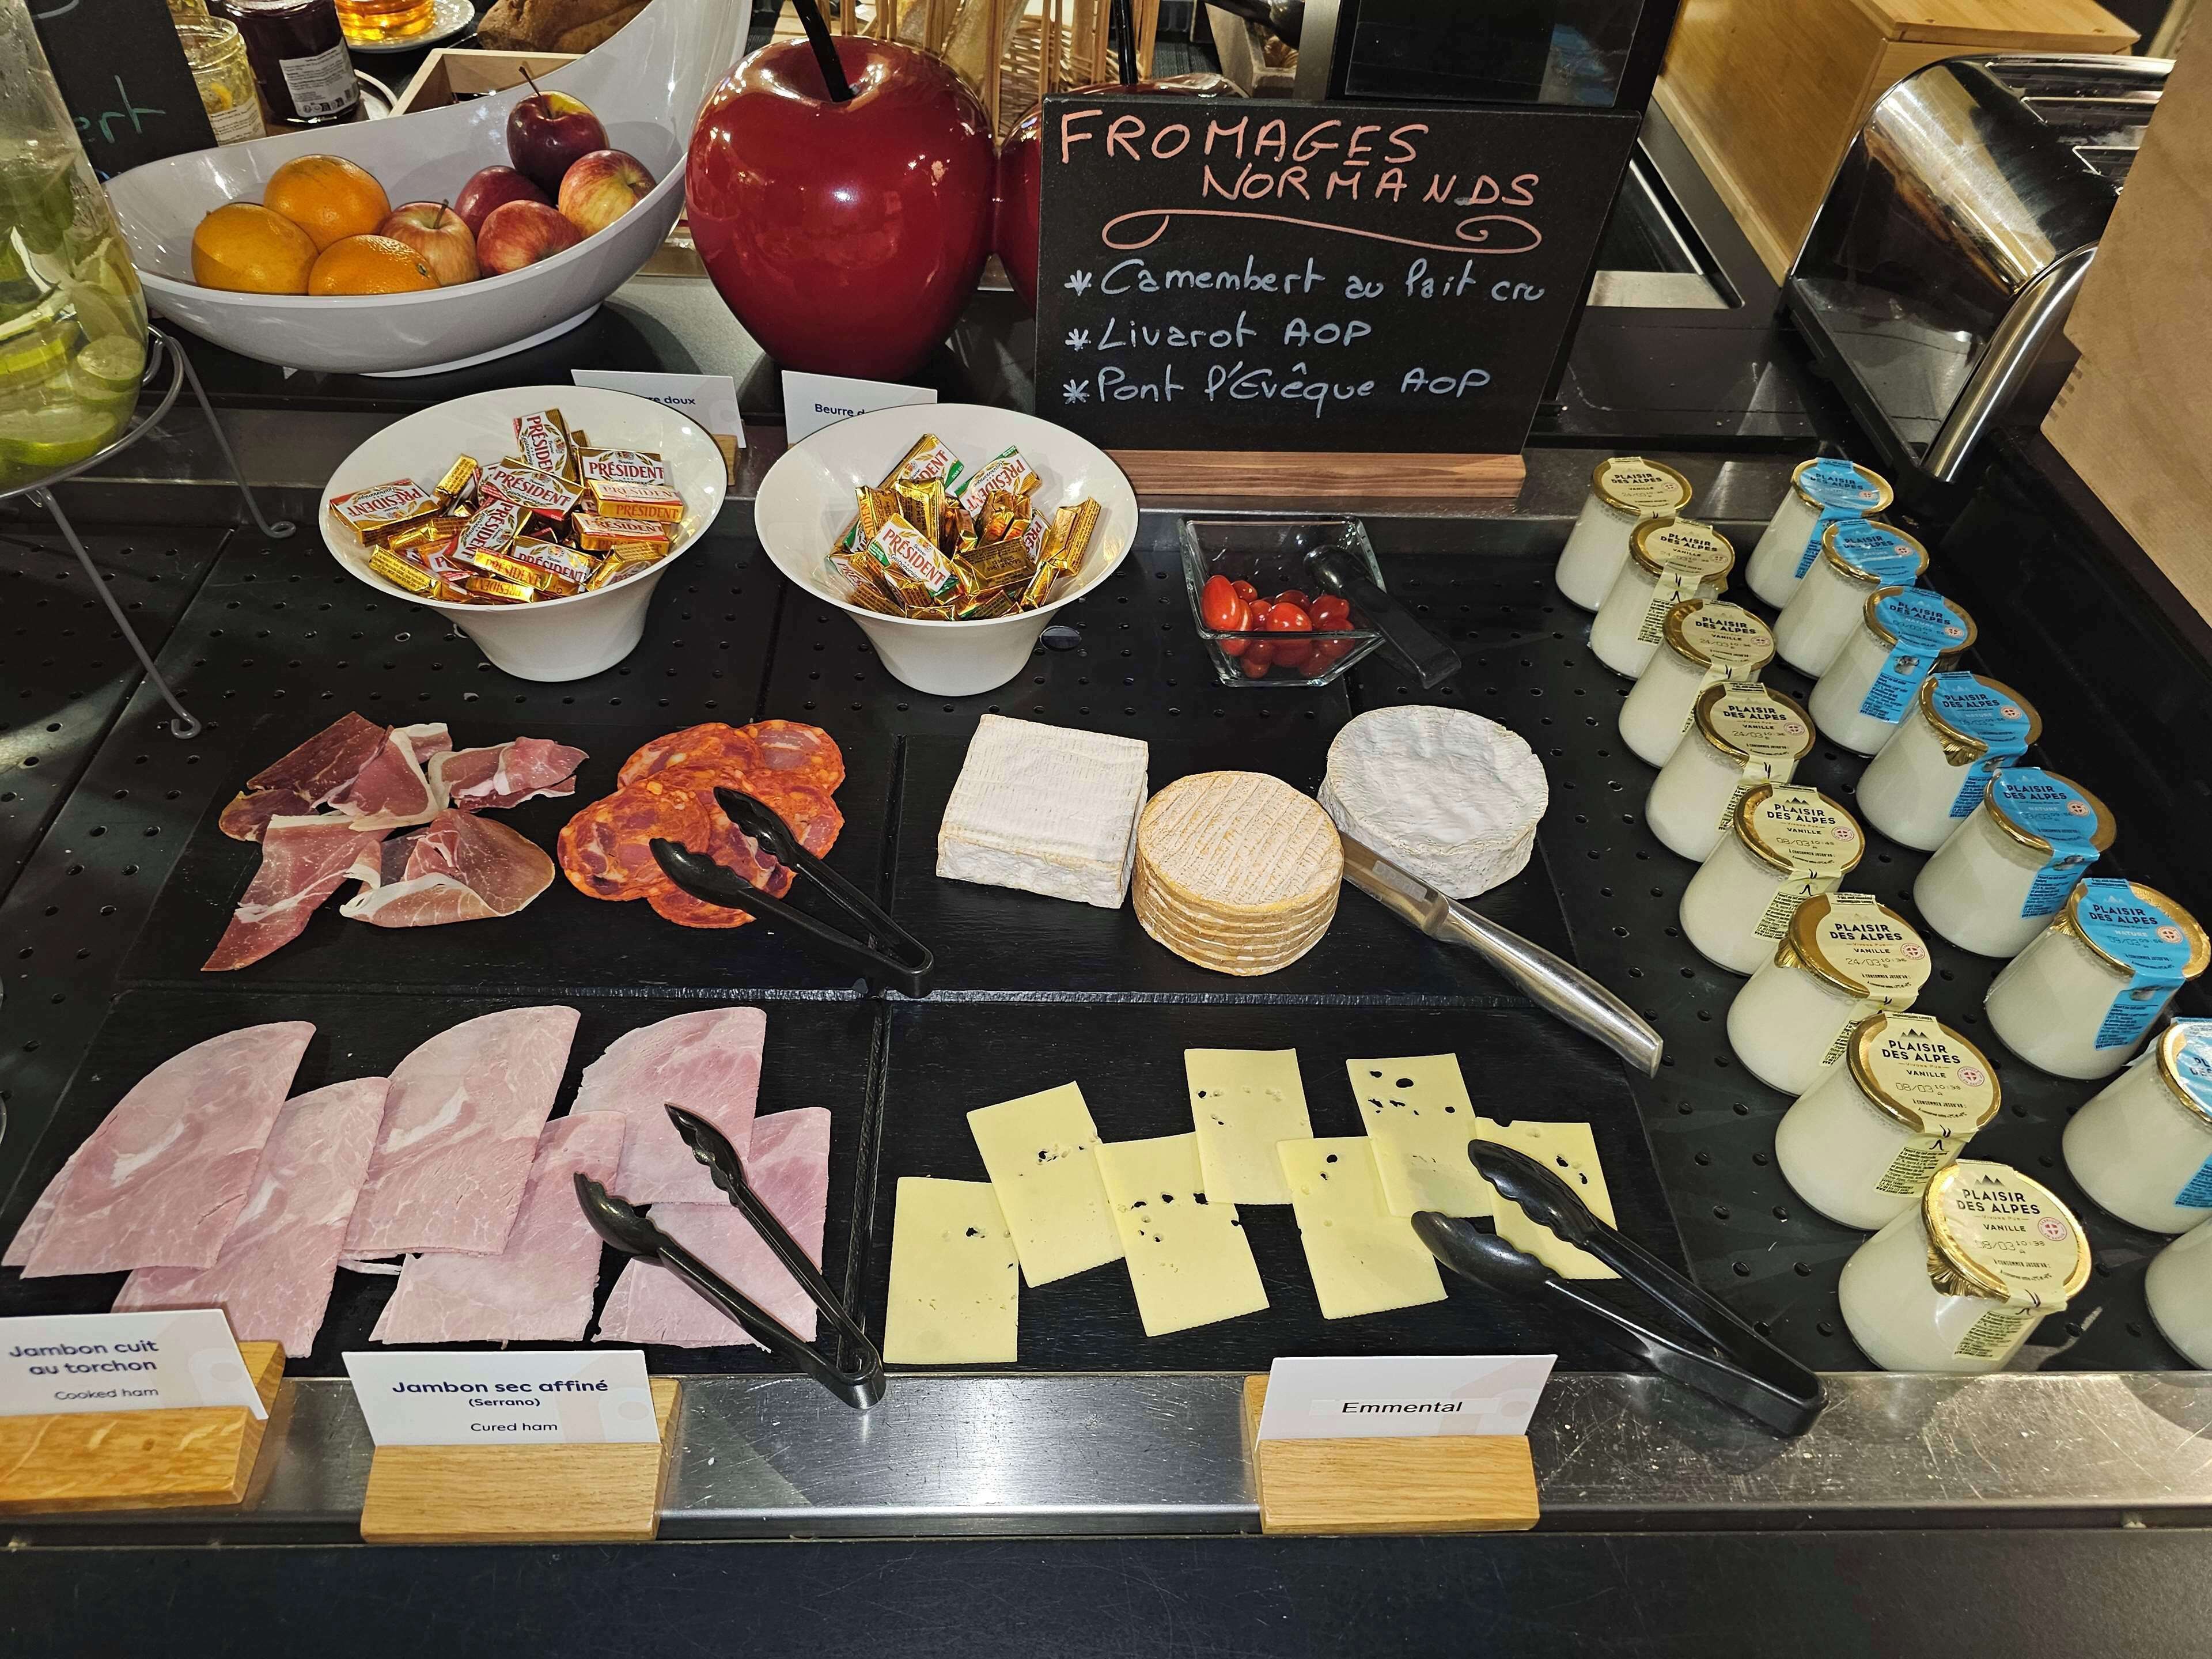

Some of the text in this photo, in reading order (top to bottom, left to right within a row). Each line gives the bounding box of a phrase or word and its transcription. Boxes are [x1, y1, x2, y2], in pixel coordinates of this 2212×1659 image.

[1060, 109, 1429, 165] FROMAGES
[1202, 162, 1539, 206] NORMANDS
[1100, 255, 1546, 301] Camembert au lait cru
[1097, 311, 1372, 349] Livarot AOP
[1098, 365, 1185, 402] Pont
[1401, 368, 1491, 399] AOP
[664, 396, 695, 404] doux
[815, 404, 853, 416] Beurre
[527, 415, 554, 472] PRÉSIDEN
[589, 460, 664, 479] PRÉSIDENT
[493, 471, 571, 506] PRÉSIDENT
[347, 488, 423, 517] PRÉSIDENT
[616, 504, 679, 518] PRÉSIDENT
[1660, 536, 1718, 552] DES ALPES
[1668, 533, 1711, 546] PLAISIR
[882, 528, 946, 586] PRÉSIDENT
[1889, 605, 1951, 625] DES ALPES
[1898, 601, 1943, 618] PLAISIR
[1702, 617, 1747, 628] PLAISIR
[1728, 705, 1777, 714] PLAISIR
[1774, 804, 1825, 817] PLAISIR
[1767, 811, 1836, 824] DES ALPES
[2092, 904, 2146, 916] PLAISIR
[2088, 912, 2158, 925] DES ALPES
[1834, 923, 1890, 932] PLAISIR
[1829, 931, 1855, 940] DES
[1888, 1039, 1947, 1054] PLAISIR
[1881, 1049, 1961, 1064] DES ALPES
[1906, 1070, 1946, 1078] VANILLE
[1895, 1082, 1934, 1093] 08/03
[1962, 1189, 2025, 1202] PLAISIR
[1957, 1200, 2040, 1214] DES ALPES
[1983, 1224, 2027, 1232] VANILLE
[8, 1339, 160, 1358] Jambon cuit
[29, 1358, 157, 1376] au torchon
[392, 1380, 609, 1393] Jambon sec affiné
[54, 1387, 159, 1400] Cooked ham
[468, 1398, 541, 1408] (Serrano)
[1342, 1401, 1463, 1414] Emmental
[470, 1422, 558, 1432] Cured ham
